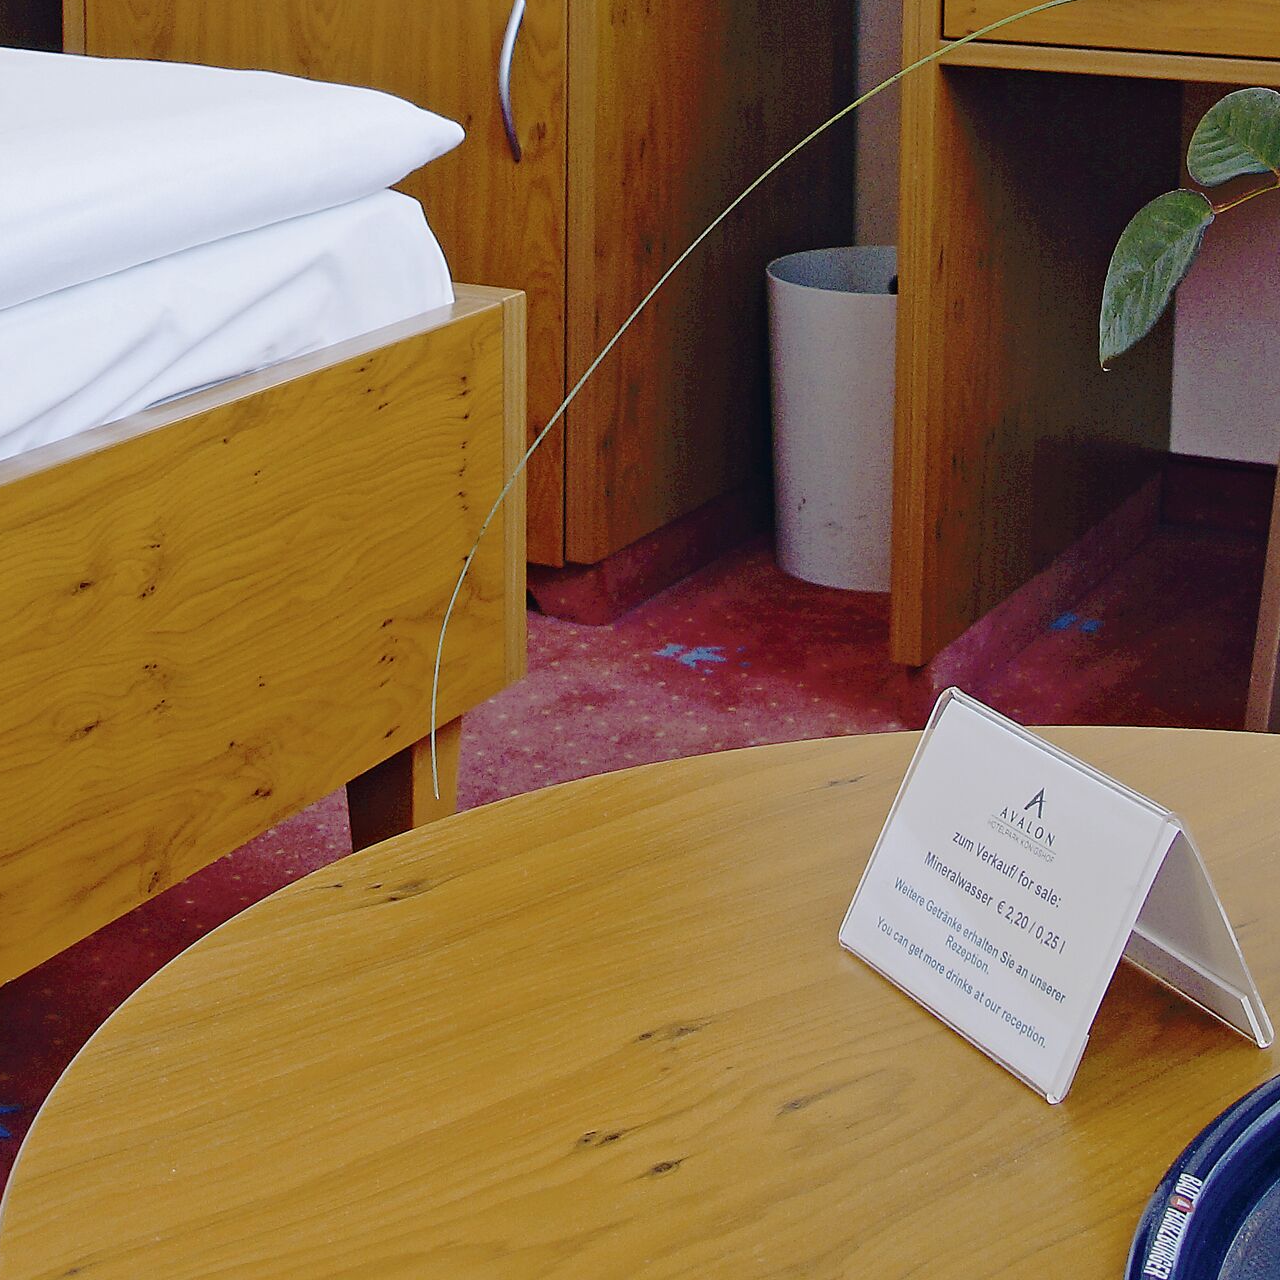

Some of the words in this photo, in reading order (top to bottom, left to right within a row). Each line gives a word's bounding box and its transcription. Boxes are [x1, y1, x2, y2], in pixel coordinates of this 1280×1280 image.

[1000, 806, 1056, 847] AVALON
[924, 851, 994, 906] Mineralwasser
[996, 900, 1006, 914] €
[1004, 905, 1029, 929] 2,20
[1035, 925, 1060, 950] 0,25
[952, 831, 974, 853] zum
[1018, 870, 1035, 890] for
[1034, 884, 1062, 908] sale:
[894, 877, 925, 906] Weitere
[926, 899, 962, 932] Getränke
[962, 929, 999, 958] erhalten
[999, 950, 1015, 969] Sie
[1015, 964, 1029, 979] an
[1029, 973, 1066, 1004] unserer
[945, 934, 990, 975] Rezeption.
[877, 916, 893, 936] You
[893, 931, 909, 948] can
[908, 943, 924, 959] get
[923, 953, 945, 974] more
[945, 969, 973, 995] drinks
[973, 989, 985, 1003] at
[984, 997, 1002, 1014] our
[1001, 1010, 1046, 1049] reception.
[1174, 1172, 1204, 1199] BAD
[1143, 1206, 1186, 1280] HARZBURGER
